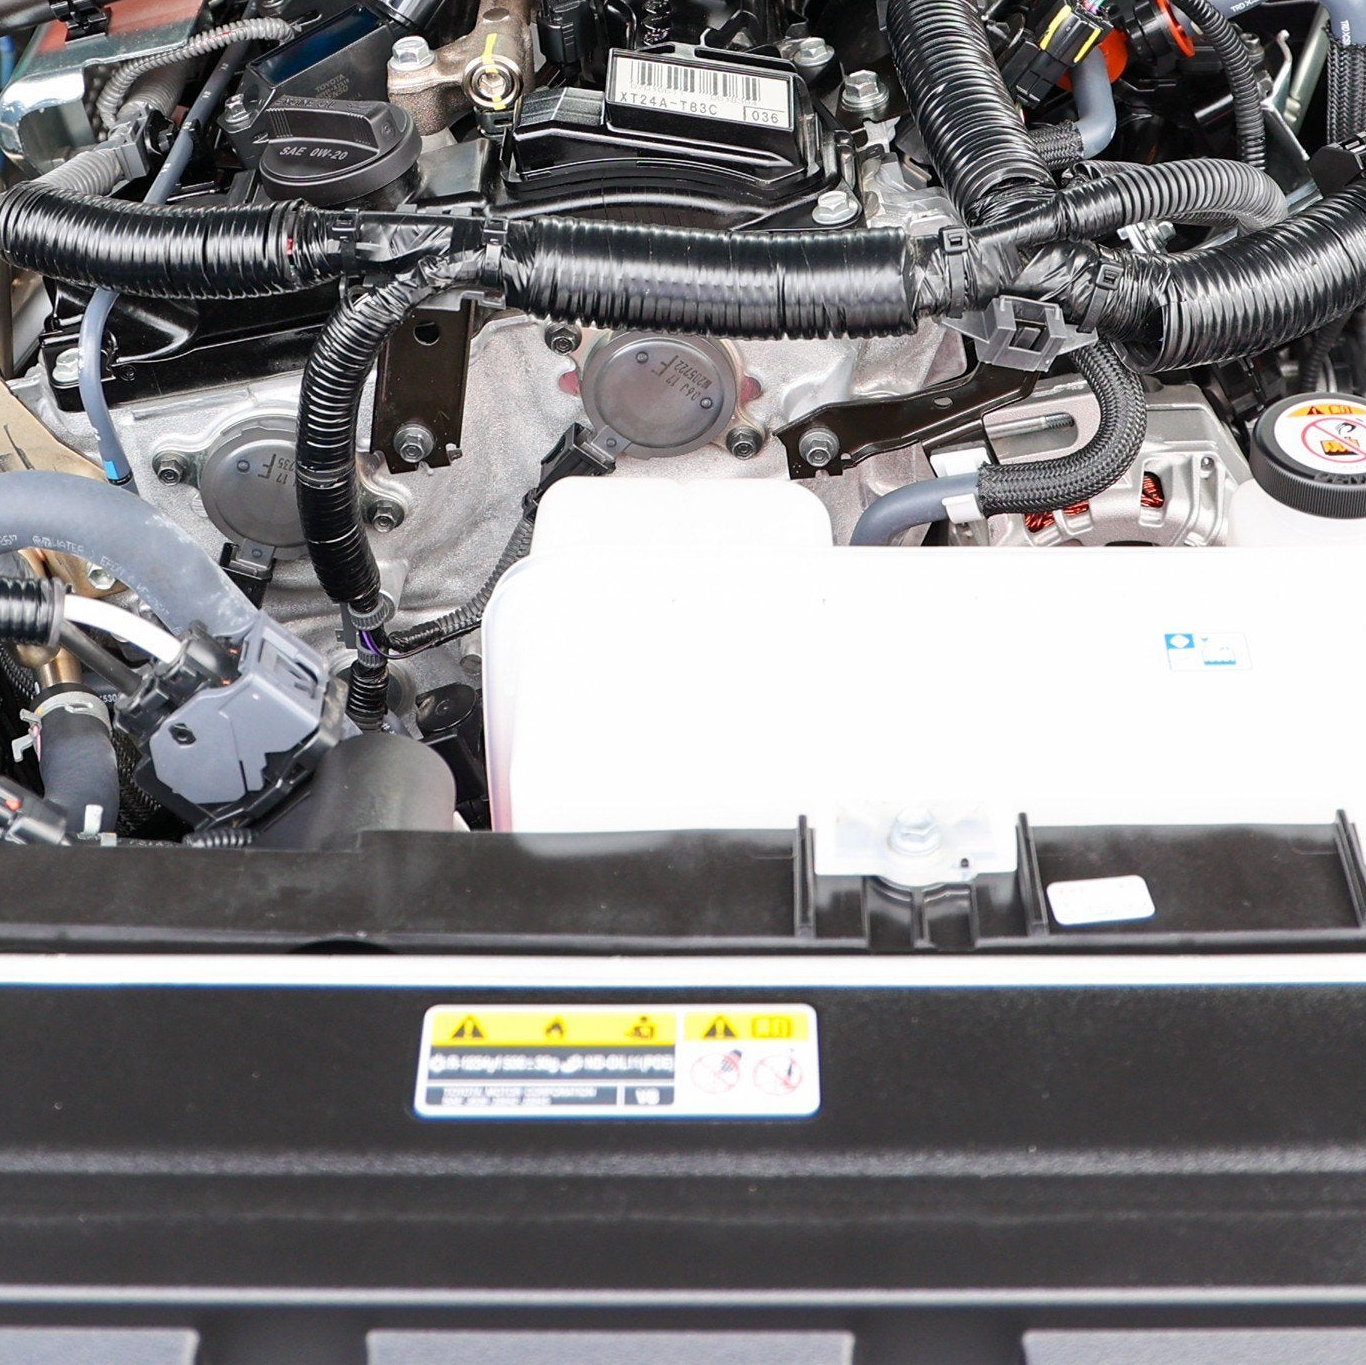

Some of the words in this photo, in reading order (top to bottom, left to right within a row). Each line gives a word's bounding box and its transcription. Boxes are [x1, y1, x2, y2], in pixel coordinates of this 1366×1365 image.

[315, 73, 346, 93] TOYOTA
[751, 110, 779, 124] 036
[279, 145, 307, 157] SAE
[309, 147, 349, 161] 0W-20
[651, 355, 680, 377] F
[665, 376, 681, 387] 17
[257, 454, 277, 479] F
